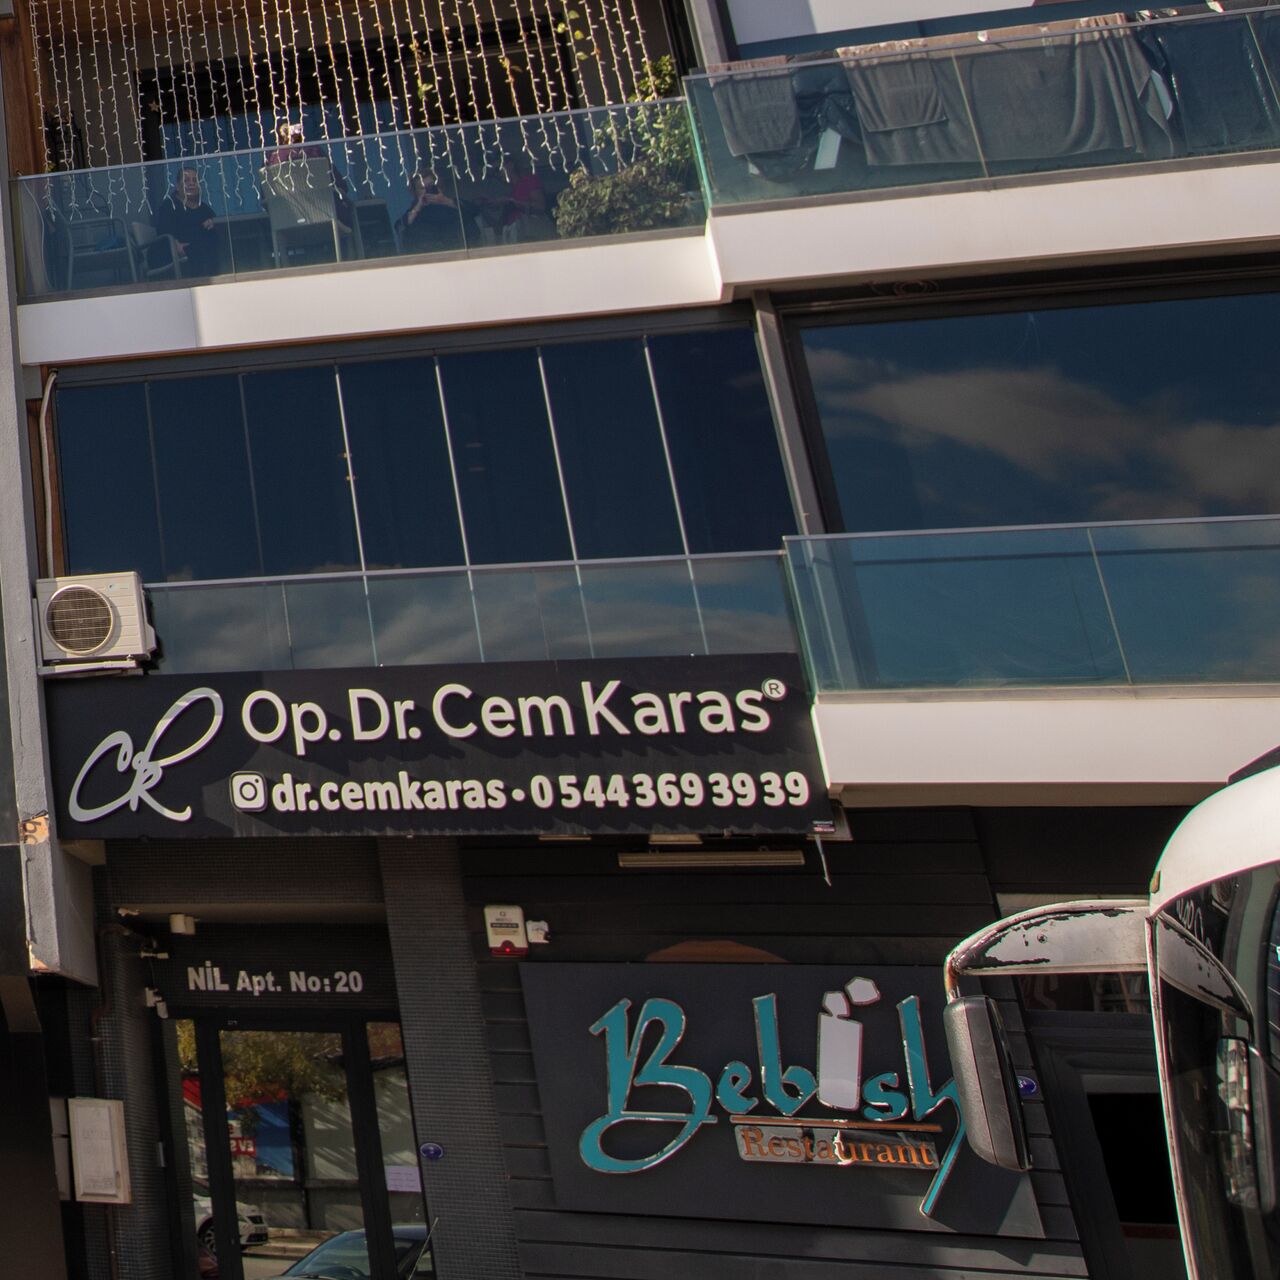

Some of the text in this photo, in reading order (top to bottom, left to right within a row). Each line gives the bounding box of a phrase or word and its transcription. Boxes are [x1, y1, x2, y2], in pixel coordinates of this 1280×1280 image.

[187, 960, 229, 992] NİL
[236, 970, 282, 997] Apt.
[741, 1127, 935, 1167] Restaurant
